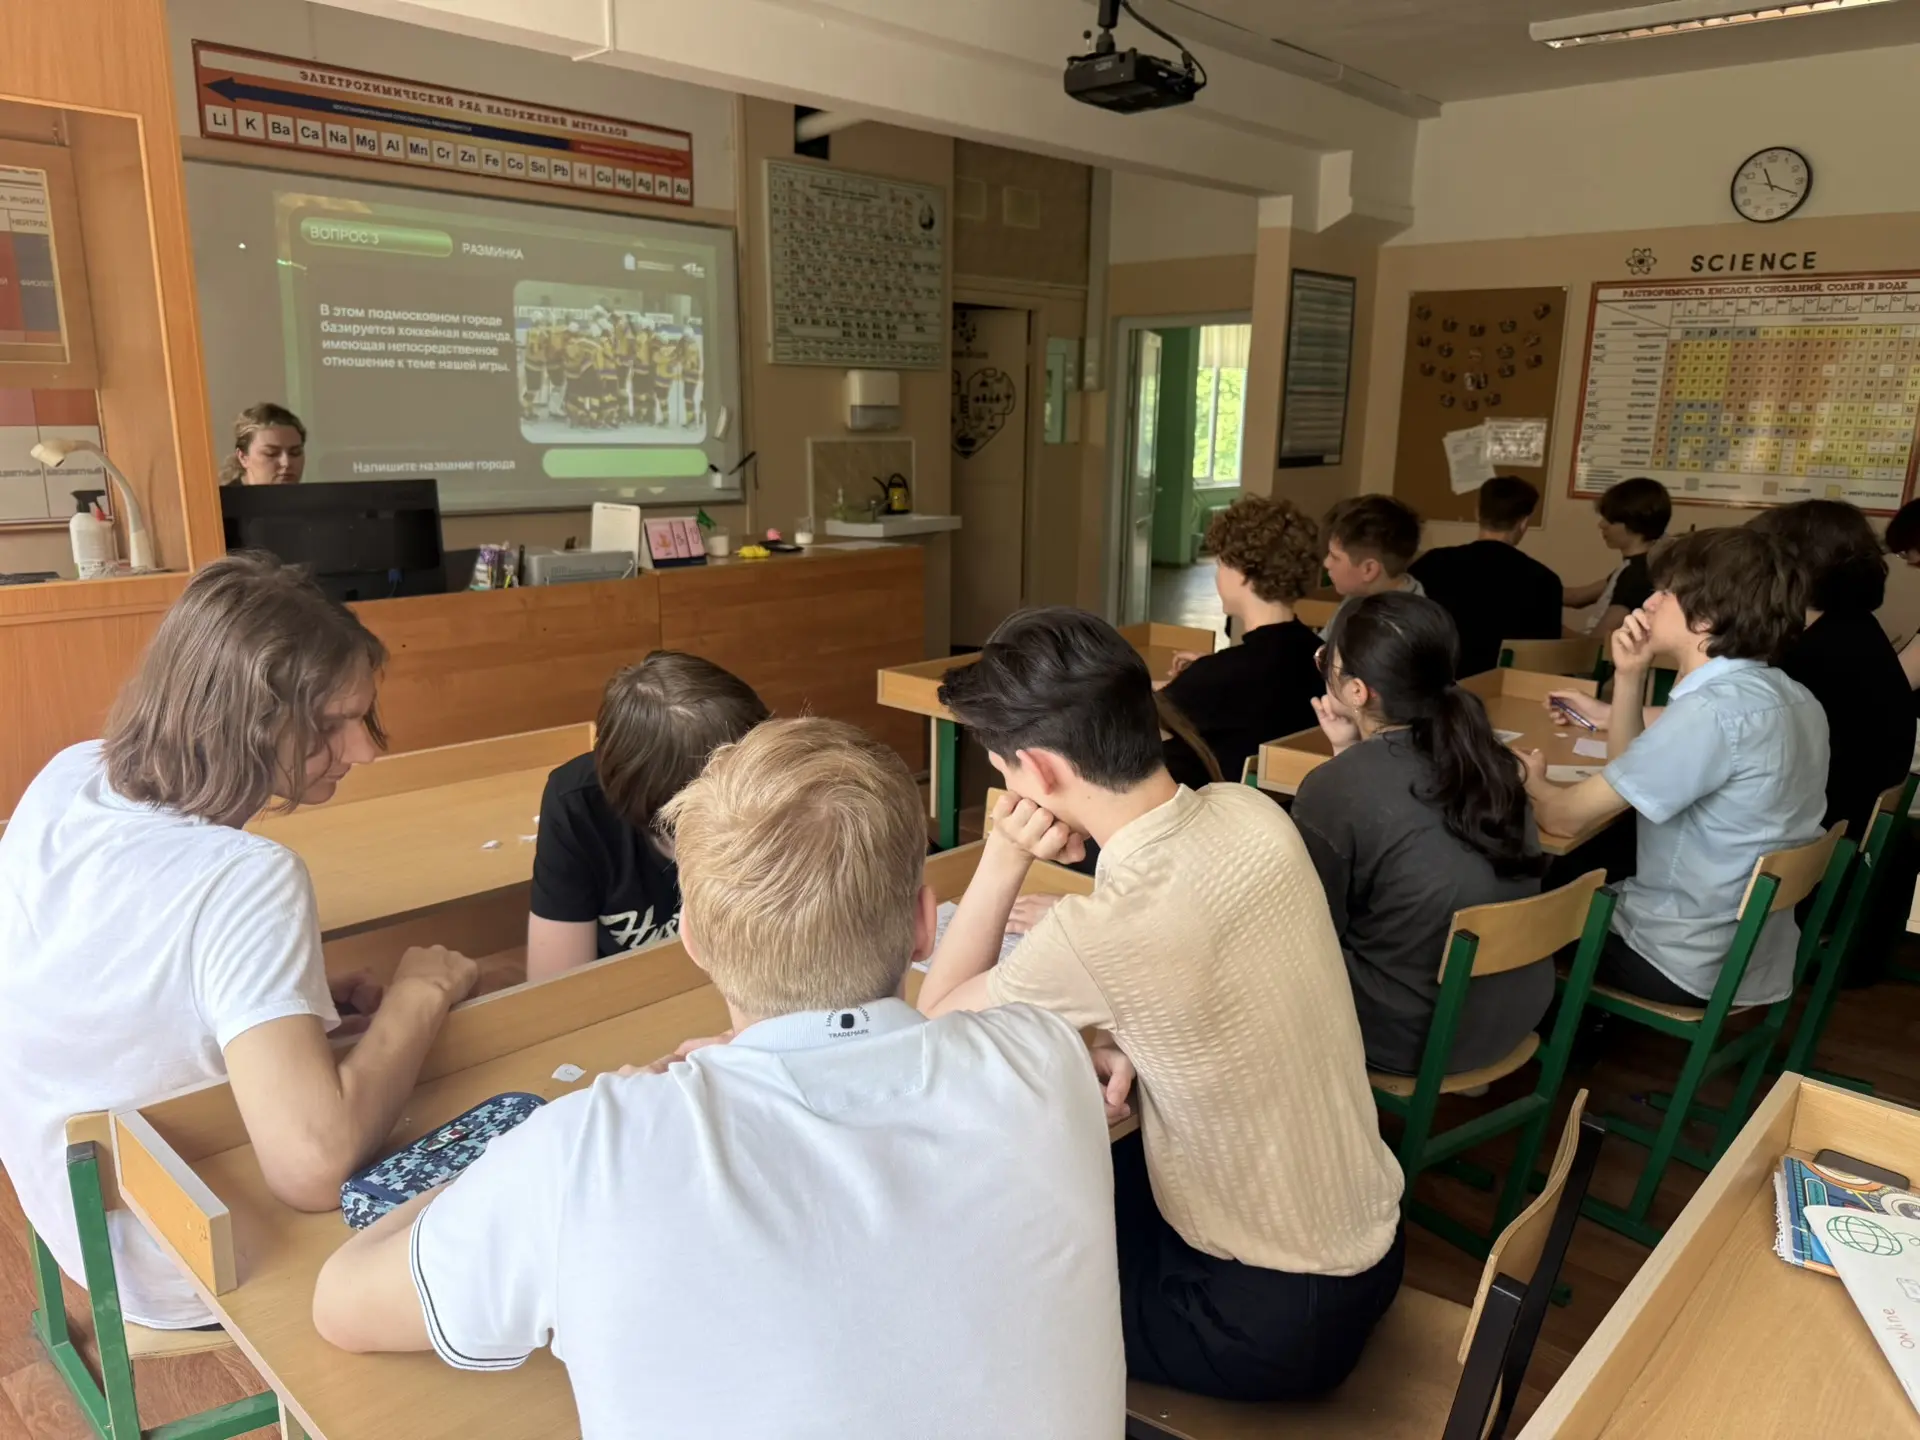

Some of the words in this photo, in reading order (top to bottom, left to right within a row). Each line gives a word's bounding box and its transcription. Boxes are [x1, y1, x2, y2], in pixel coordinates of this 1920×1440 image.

[300, 70, 454, 107] ЭЛЕКТРОХИМИЧЕСКИЙ
[459, 99, 482, 114] РЯД
[486, 104, 568, 127] НАПРЯЖЕНИЙ
[572, 120, 628, 138] МЕТАЛЛОВ
[213, 112, 226, 127] Li
[246, 118, 256, 131] K
[272, 122, 290, 136] Ba
[301, 126, 320, 140] Ca
[329, 130, 347, 144] Na
[356, 134, 376, 150] Mg
[410, 143, 428, 156] Mn
[437, 147, 451, 160] Cr
[460, 151, 476, 163] Zn
[485, 155, 499, 167] Fe
[507, 158, 524, 170] Co
[531, 162, 546, 174] Sn
[554, 164, 568, 177] Pb
[579, 168, 587, 179] H
[618, 174, 632, 188] Hg
[638, 178, 651, 192] Ag
[658, 180, 668, 192] Pt
[676, 184, 689, 195] Au
[310, 226, 369, 243] ВОПРОС
[372, 233, 380, 245] 3
[462, 242, 524, 260] РАЗМИНКА
[1690, 251, 1817, 273] SCIENCE
[1622, 288, 1705, 298] РАСТВОРИМОСТЬ
[1827, 281, 1865, 291] СОЛЕЙ
[1868, 282, 1875, 290] В
[1878, 281, 1908, 290] ВОДЕ
[320, 304, 330, 316] В
[333, 307, 365, 318] этом
[368, 310, 460, 324] подмосковном
[462, 314, 502, 328] городе
[321, 321, 396, 337] базируется
[398, 325, 459, 338] хоккейная
[462, 329, 514, 343] команда,
[322, 340, 385, 352] имеющая
[388, 342, 499, 358] непосредственное
[323, 357, 396, 369] отношение
[407, 359, 436, 369] теме
[438, 358, 476, 371] нашей
[480, 360, 510, 373] игры.
[353, 461, 417, 473] Напишите
[419, 460, 475, 472] название
[476, 458, 516, 471] города
[828, 1028, 869, 1038] TRADEMARK
